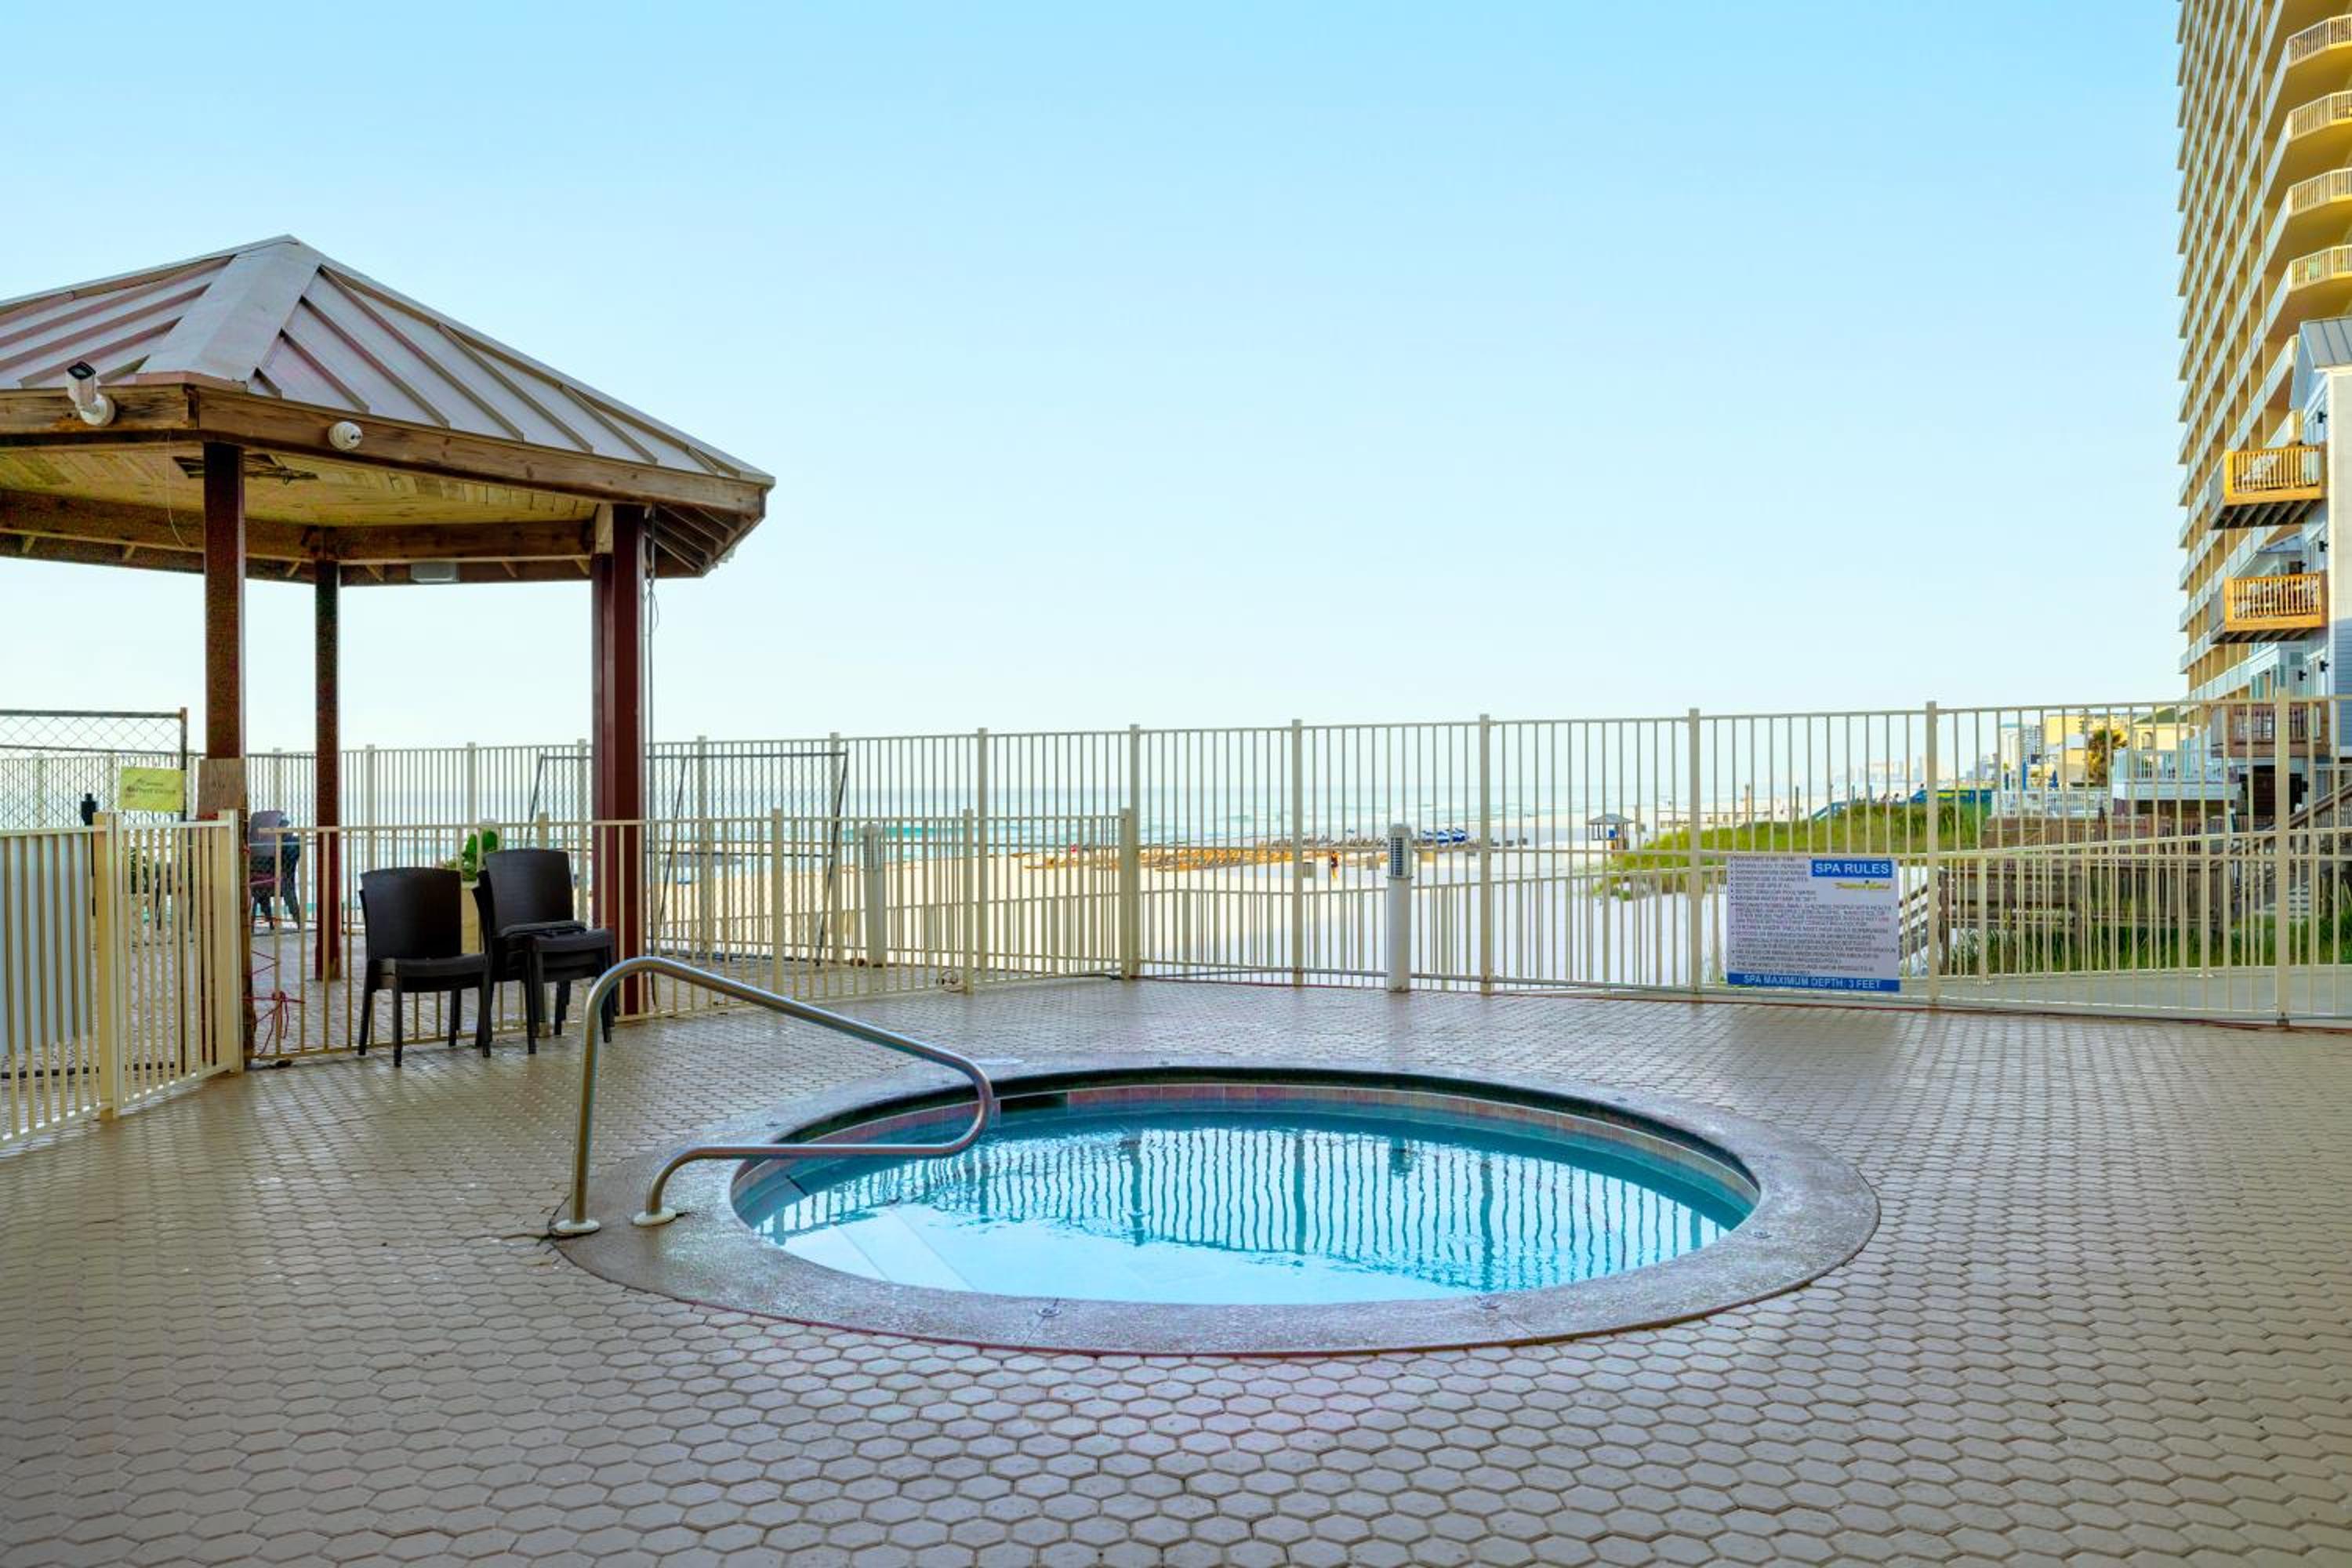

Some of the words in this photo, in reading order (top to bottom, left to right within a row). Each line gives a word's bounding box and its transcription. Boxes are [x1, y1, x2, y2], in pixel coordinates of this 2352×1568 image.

[1814, 863, 1841, 874] SPA
[1844, 863, 1889, 875] RULES
[1744, 975, 1762, 984] SPA
[1763, 975, 1809, 986] MAXIMUM
[1848, 978, 1855, 989] 3
[1856, 978, 1881, 989] FEET
